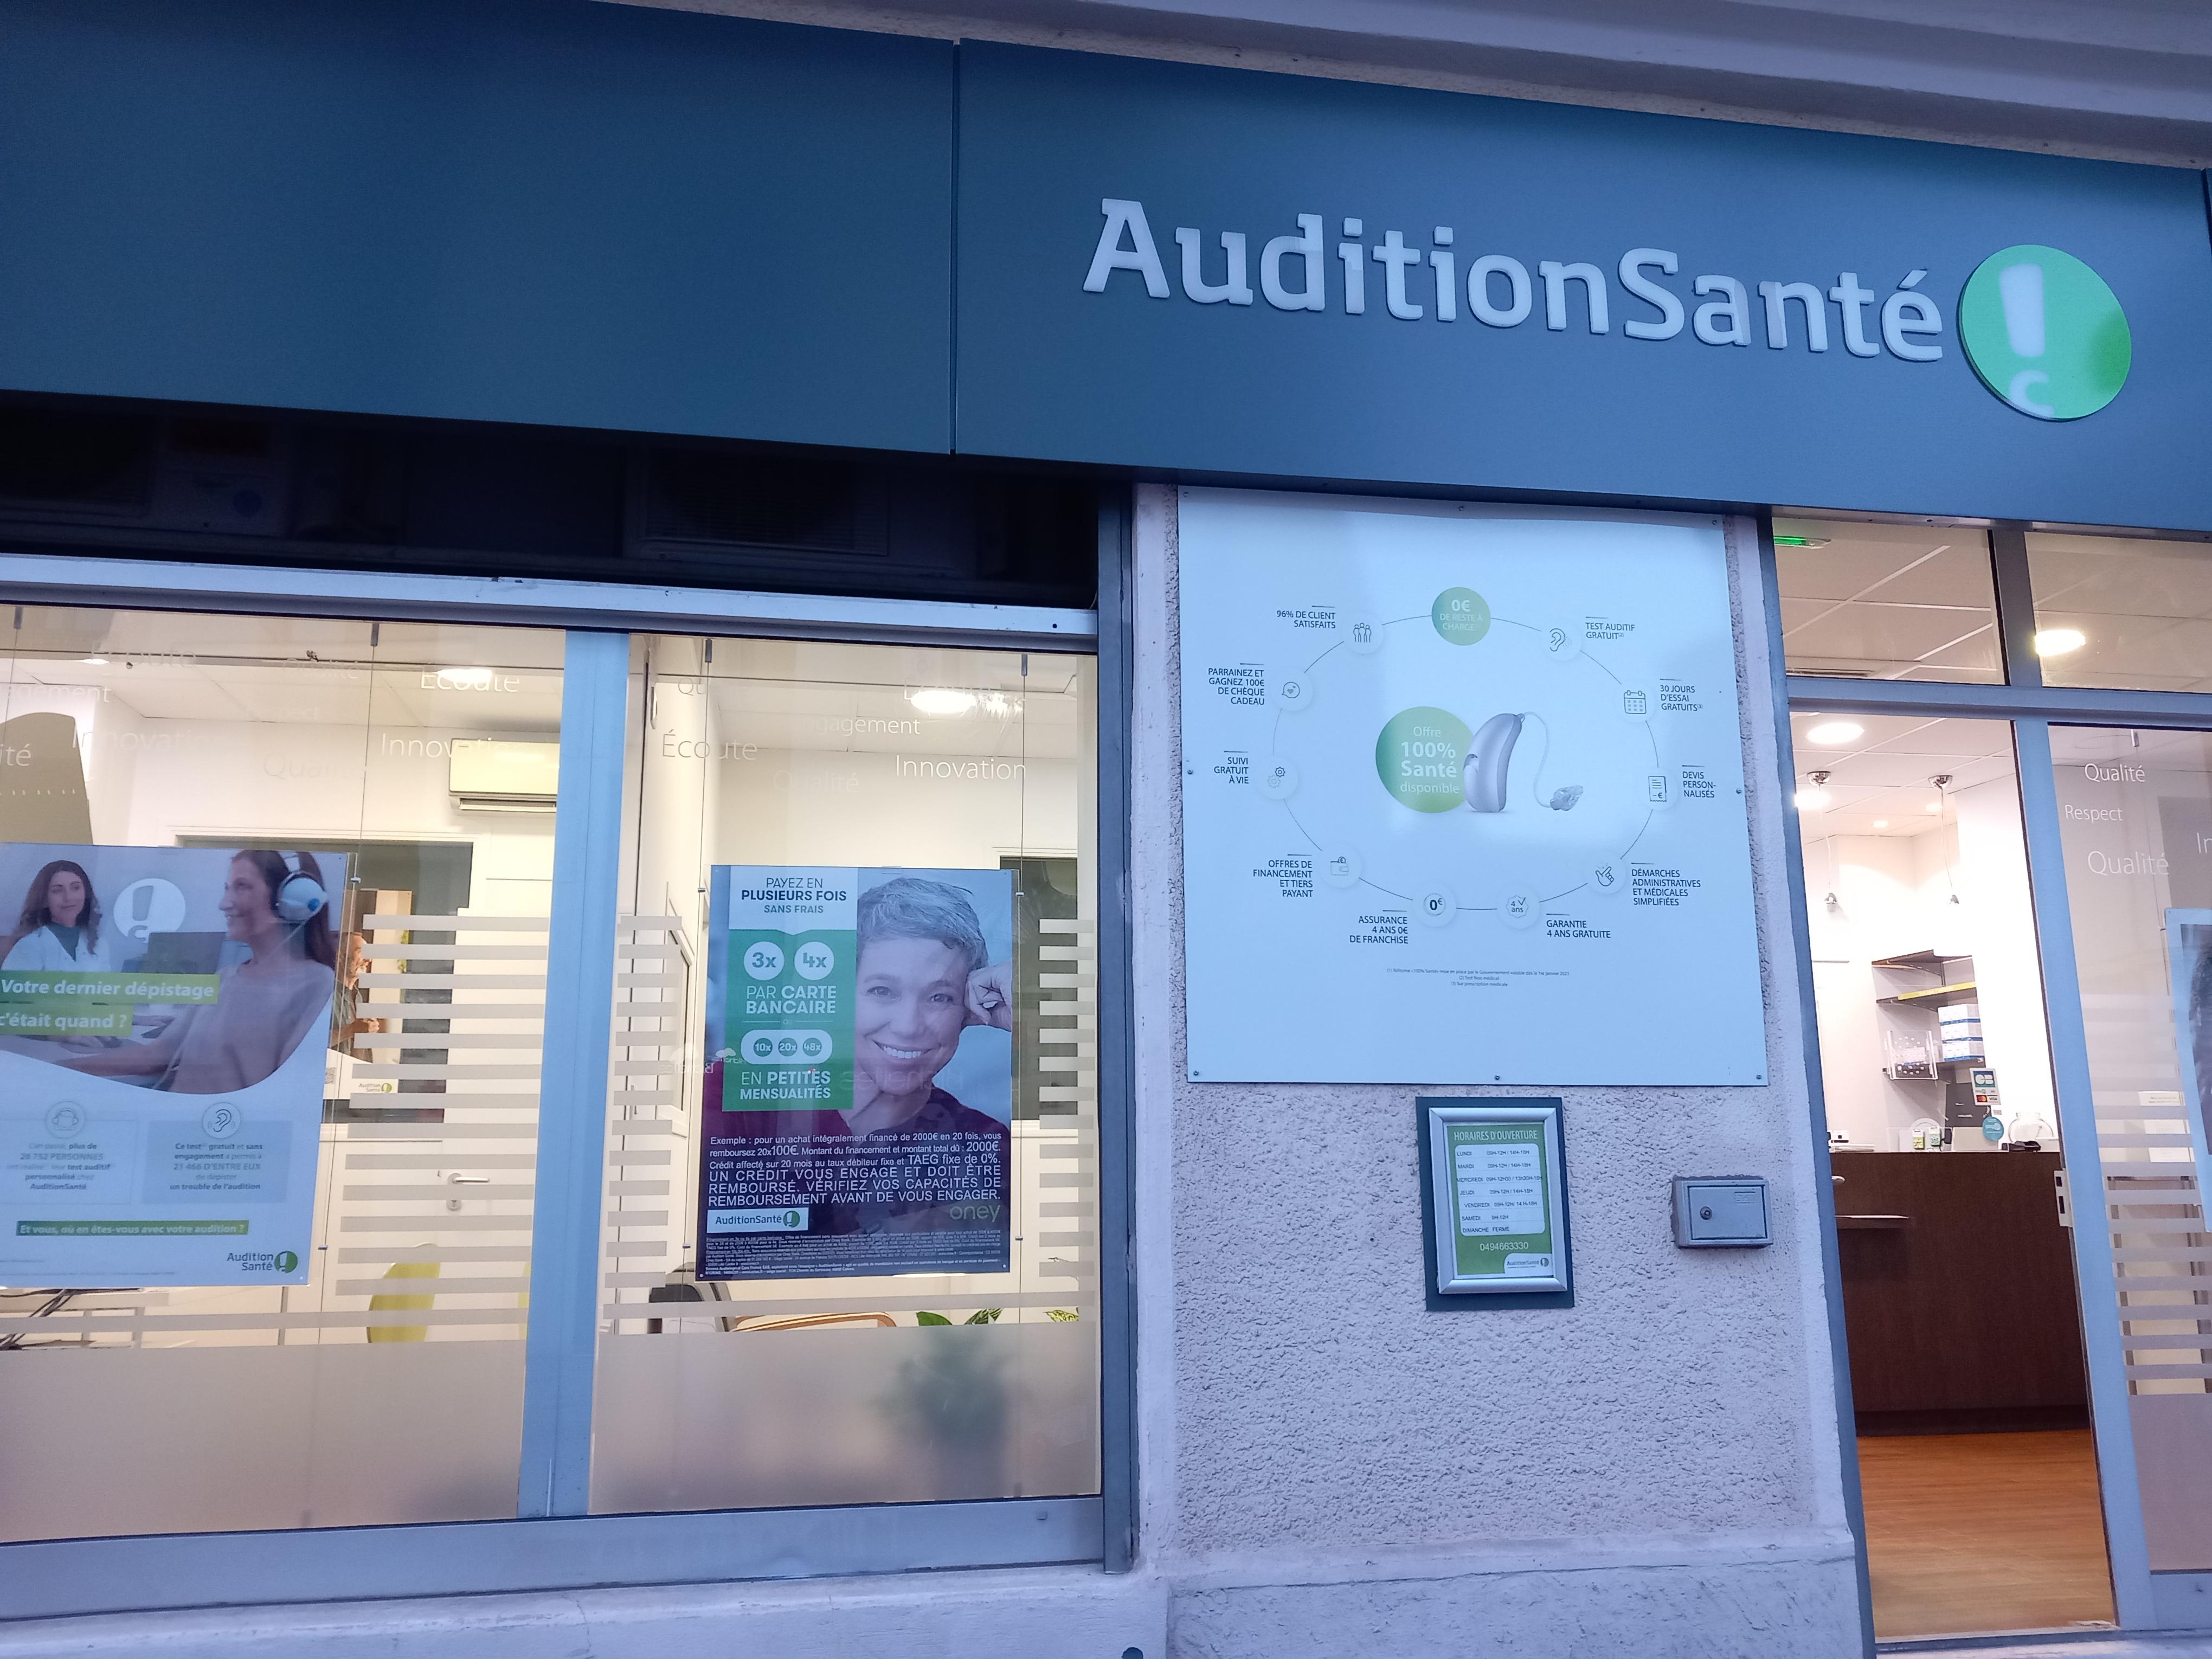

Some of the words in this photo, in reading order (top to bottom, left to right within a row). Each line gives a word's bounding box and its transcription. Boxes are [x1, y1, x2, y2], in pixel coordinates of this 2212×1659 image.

[1083, 198, 1942, 362] AuditionSanté
[1451, 599, 1470, 612] 0€
[1276, 610, 1294, 618] 96%
[1308, 612, 1336, 620] CLIENT
[1440, 613, 1450, 621] DE
[1294, 620, 1336, 629] SATISFAITS
[1585, 622, 1604, 630] TEST
[1605, 623, 1635, 632] AUDITIF
[1208, 668, 1253, 677] PARRAINEZ
[1208, 678, 1243, 686] GAGNEZ
[1218, 687, 1229, 695] DE
[1230, 686, 1265, 697] CHÈQUE
[1660, 685, 1670, 693] 30
[1671, 685, 1695, 693] JOURS
[1231, 697, 1264, 705] CADEAU
[1661, 693, 1689, 702] D'ESSAI
[1413, 726, 1441, 738] Offre
[1401, 741, 1456, 759] 100%
[1227, 757, 1249, 765] SUIVI
[895, 755, 1026, 780] Innovation
[1214, 766, 1249, 774] GRATUIT
[1401, 760, 1457, 778] Santé
[2085, 763, 2145, 782] Qualité
[1229, 775, 1235, 784] À
[1682, 771, 1705, 779] DEVIS
[1400, 781, 1459, 795] disponible
[1683, 781, 1716, 789] PERSON-
[1684, 788, 1715, 798] NALISÉS
[2065, 805, 2124, 823] Respect
[1268, 859, 1299, 869] OFFRES
[1301, 860, 1312, 869] DE
[2088, 851, 2169, 876] Qualité
[1253, 869, 1313, 878] FINANCEMENT
[1631, 867, 1680, 878] DÉMARCHES
[766, 877, 803, 888] PAYEZ
[807, 878, 822, 888] EN
[1279, 879, 1290, 888] ET
[1291, 879, 1313, 888] TIERS
[1632, 879, 1701, 888] ADMINISTRATIVES
[741, 890, 812, 901] PLUSIEURS
[816, 891, 847, 901] FOIS
[1282, 890, 1313, 898] PAYANT
[1632, 889, 1642, 897] ET
[1643, 887, 1688, 897] MÉDICALES
[1634, 896, 1679, 906] SIMPLIFIÉES
[764, 905, 792, 913] SANS
[1359, 916, 1408, 924] ASSURANCE
[1546, 919, 1587, 929] GARANTIE
[1379, 926, 1396, 934] ANS
[1398, 926, 1409, 935] 0€
[1554, 930, 1571, 938] ANS
[1572, 930, 1611, 938] GRATUITE
[1349, 935, 1361, 943] DE
[1362, 935, 1409, 944] FRANCHISE
[752, 952, 776, 968] 3x
[802, 952, 827, 968] 4x
[1, 979, 49, 994] Votre
[54, 980, 120, 995] dernier
[125, 982, 214, 1000] dépistage
[747, 986, 776, 999] PAR
[781, 986, 837, 999] CARTE
[746, 1000, 835, 1014] BANCAIRE
[54, 1014, 113, 1031] quand
[755, 1043, 771, 1051] 10x
[779, 1043, 797, 1051] 20x
[803, 1043, 821, 1051] 48x
[742, 1072, 762, 1085] EN
[767, 1070, 831, 1085] PETITES
[740, 1085, 831, 1099] MENSUALITÉS
[711, 1136, 746, 1146] Exemple
[754, 1137, 773, 1146] pour
[788, 1135, 811, 1143] achat
[813, 1134, 867, 1144] intégralement
[869, 1133, 897, 1142] financé
[912, 1133, 938, 1141] 2000€
[965, 1132, 981, 1141] fois,
[1454, 1131, 1489, 1141] HORAIRES
[1490, 1130, 1538, 1140] D'OUVERTURE
[710, 1148, 755, 1157] remboursez
[801, 1147, 832, 1155] Montant
[834, 1146, 844, 1155] du
[845, 1145, 891, 1155] financement
[902, 1145, 931, 1153] montant
[933, 1144, 948, 1153] total
[950, 1144, 960, 1152] dû
[966, 1141, 1001, 1152] 2000€.
[709, 1160, 734, 1169] Crédit
[736, 1160, 763, 1169] affecté
[846, 1158, 878, 1166] débiteur
[907, 1154, 938, 1165] TAEG
[942, 1154, 961, 1164] fixe
[964, 1154, 978, 1164] de
[981, 1153, 1001, 1163] 0%.
[709, 1171, 729, 1182] UN
[736, 1167, 788, 1181] CRÉDIT
[795, 1169, 833, 1180] VOUS
[840, 1167, 898, 1179] ENGAGE
[904, 1167, 921, 1177] ET
[928, 1166, 960, 1176] DOIT
[966, 1163, 1001, 1175] ÊTRE
[709, 1180, 800, 1194] REMBOURSÉ.
[806, 1179, 867, 1192] VÉRIFIEZ
[872, 1179, 900, 1190] VOS
[905, 1175, 978, 1189] CAPACITÉS
[983, 1177, 1001, 1187] DE
[708, 1193, 827, 1207] REMBOURSEMENT
[831, 1192, 872, 1204] AVANT
[877, 1192, 893, 1202] DE
[898, 1191, 933, 1201] VOUS
[937, 1189, 1001, 1201] ENGAGER.
[715, 1215, 782, 1225] AuditionSanté
[949, 1205, 1001, 1223] oney
[1480, 1242, 1529, 1251] 0494663330
[227, 1252, 273, 1262] Audition
[241, 1261, 272, 1271] Santé
